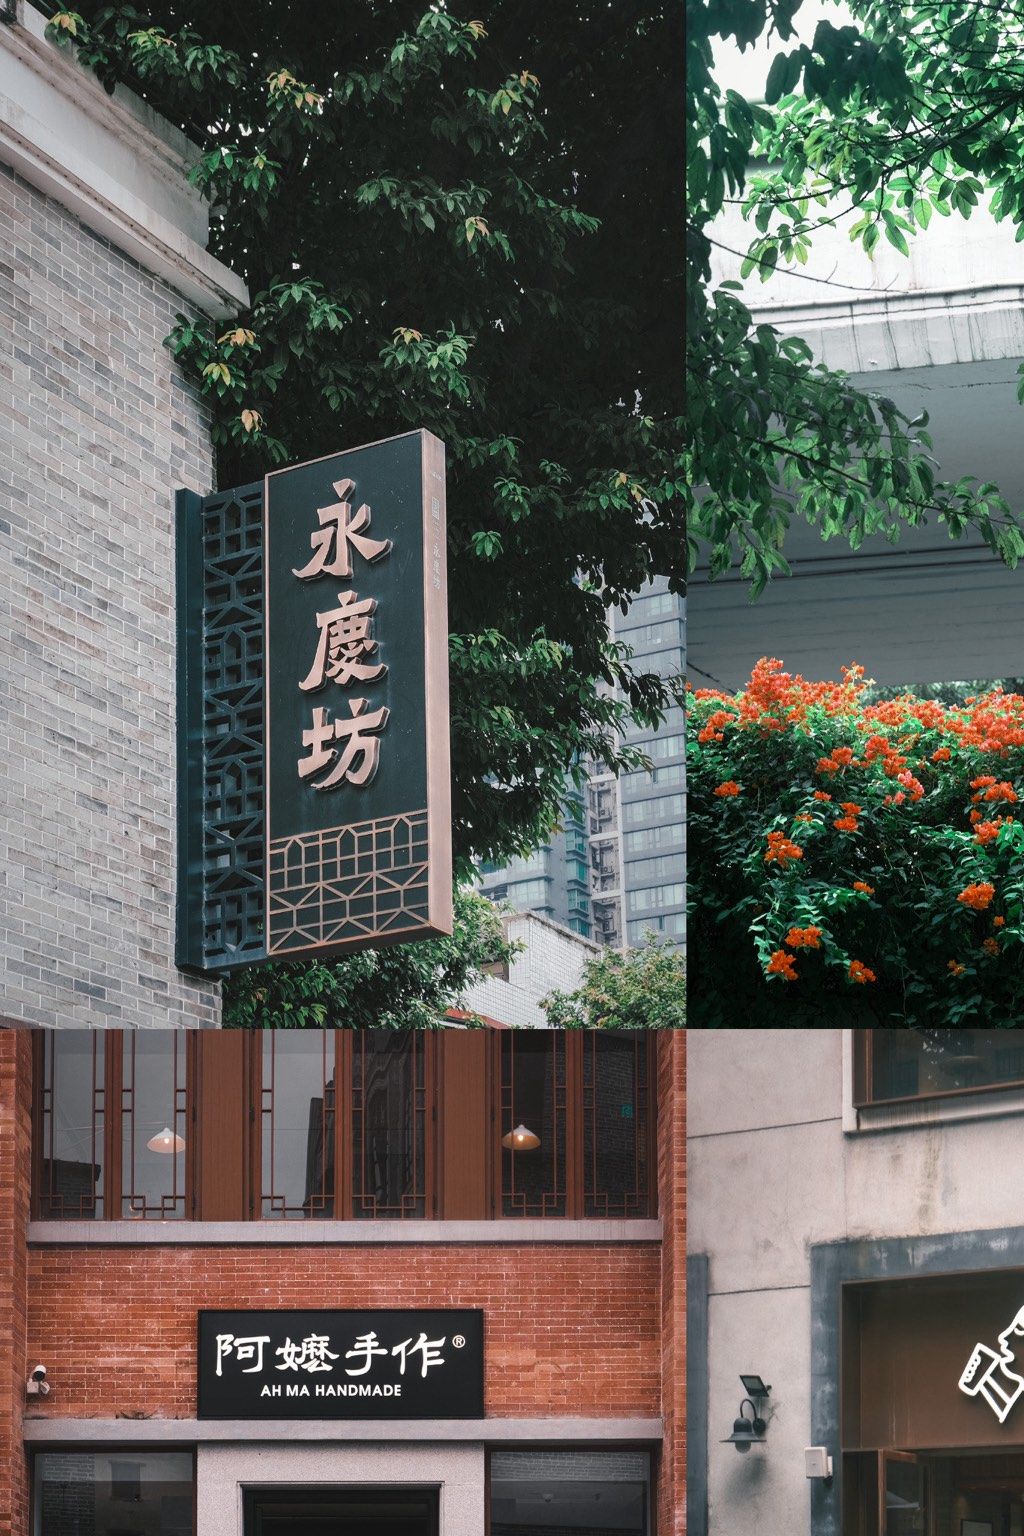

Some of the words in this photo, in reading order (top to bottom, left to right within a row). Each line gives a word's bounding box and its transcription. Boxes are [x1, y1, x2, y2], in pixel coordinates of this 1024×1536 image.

[292, 478, 395, 790] 永慶坊
[260, 1384, 282, 1397] AH
[286, 1384, 310, 1397] MA
[315, 1384, 402, 1397] HANDMADE
